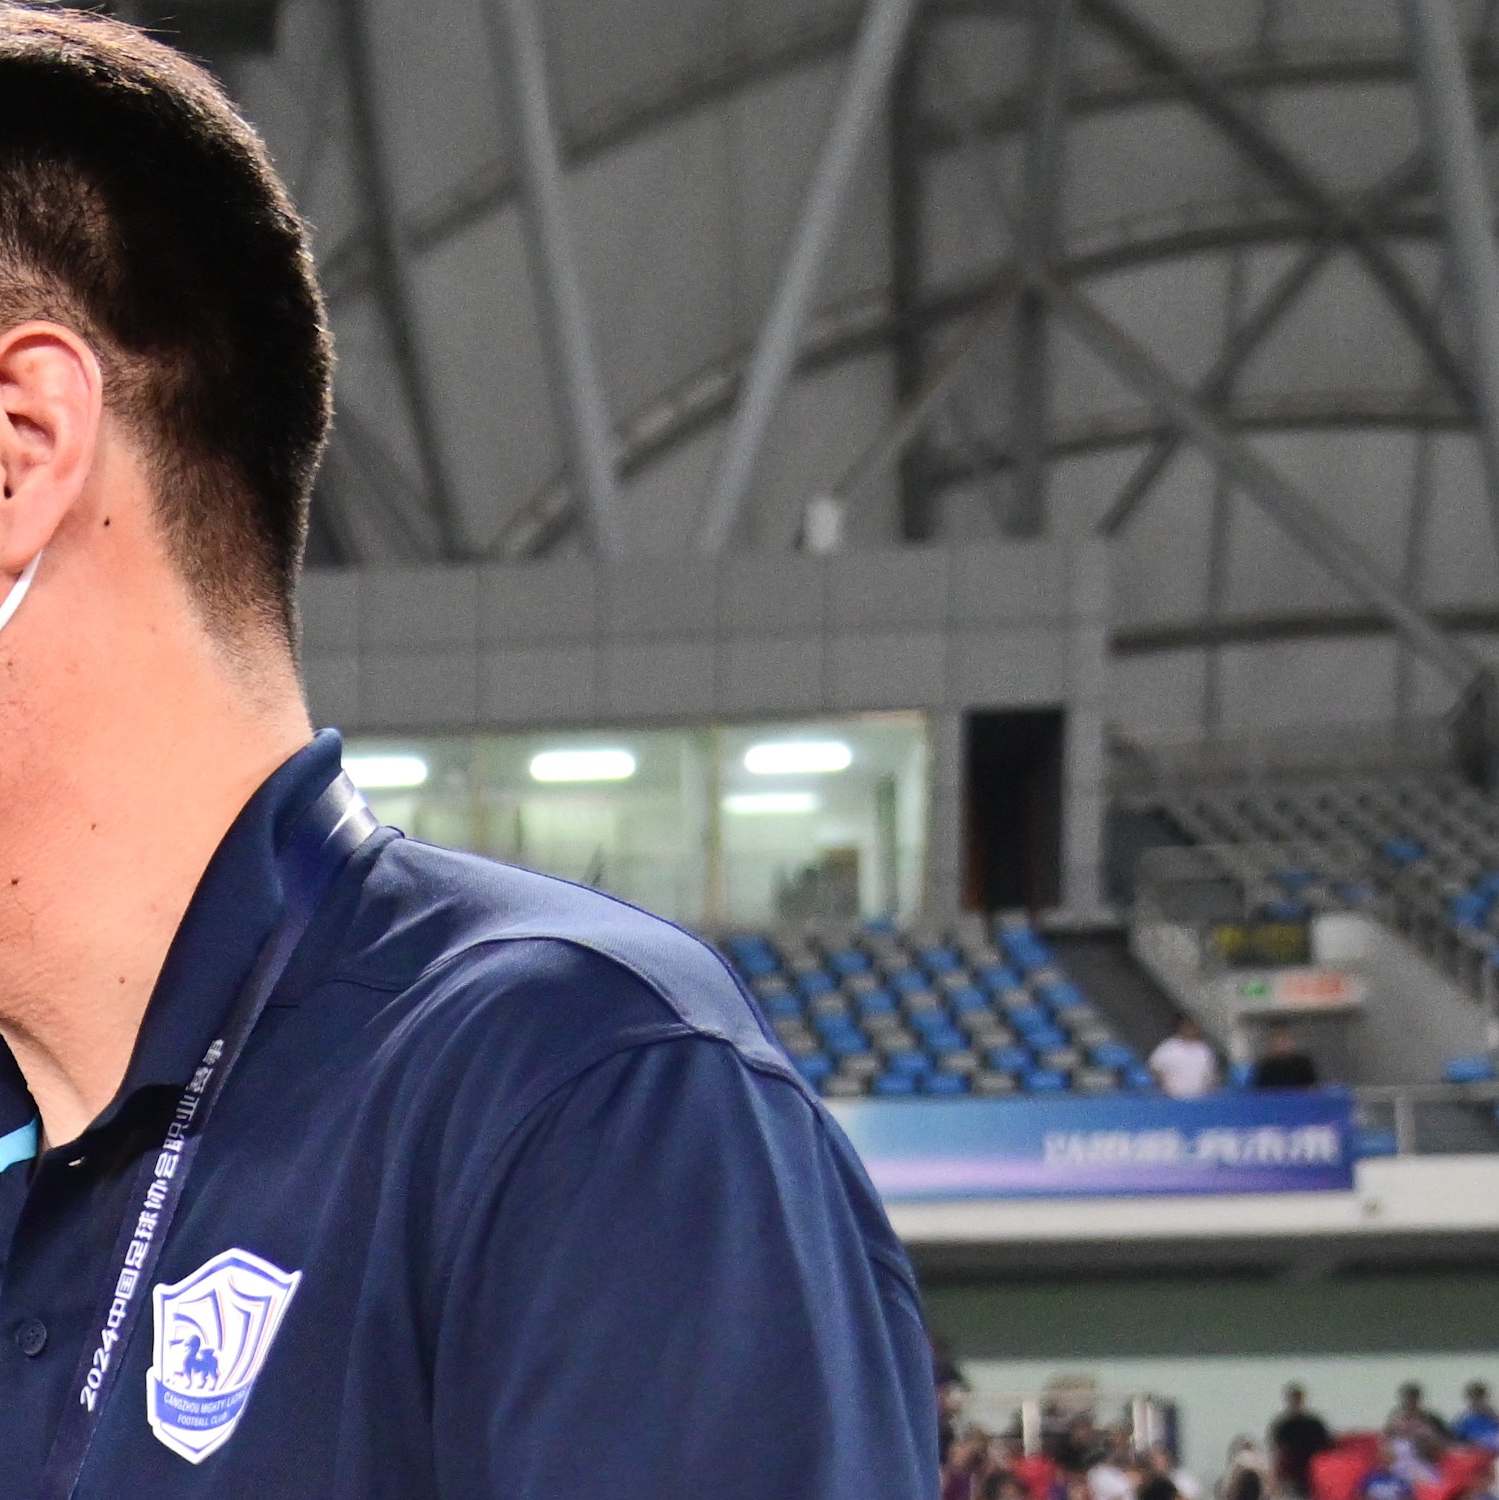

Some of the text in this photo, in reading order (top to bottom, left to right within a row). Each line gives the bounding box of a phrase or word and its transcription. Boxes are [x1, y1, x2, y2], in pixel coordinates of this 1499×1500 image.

[80, 1038, 224, 1412] 2024中国足球协会职业赛事
[164, 1391, 200, 1413] CANGZHOU
[200, 1399, 226, 1413] MIGHTY
[177, 1411, 229, 1427] FOOTBALL CLUB
